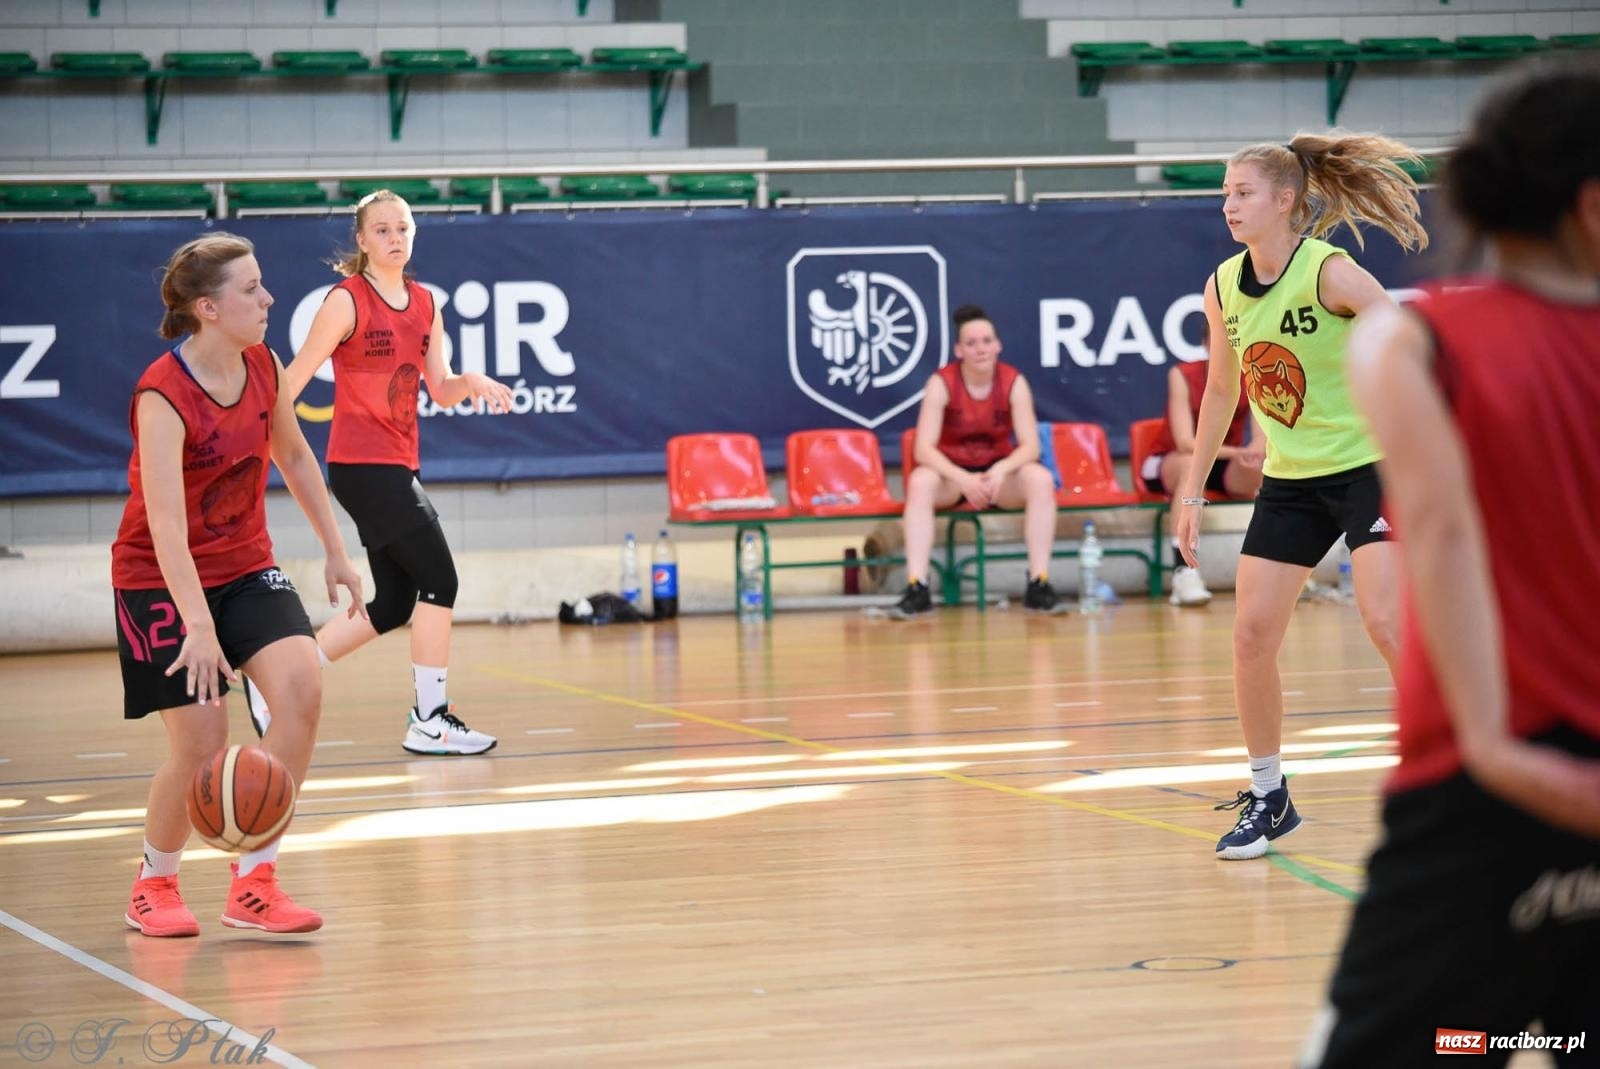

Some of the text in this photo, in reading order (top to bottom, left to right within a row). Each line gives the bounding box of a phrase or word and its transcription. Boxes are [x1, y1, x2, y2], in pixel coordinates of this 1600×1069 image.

[1280, 305, 1318, 337] 45
[364, 330, 394, 340] LETNIA
[370, 339, 391, 349] LIGA
[421, 334, 431, 357] 5
[364, 348, 395, 358] KOBIET
[149, 601, 187, 648] 2
